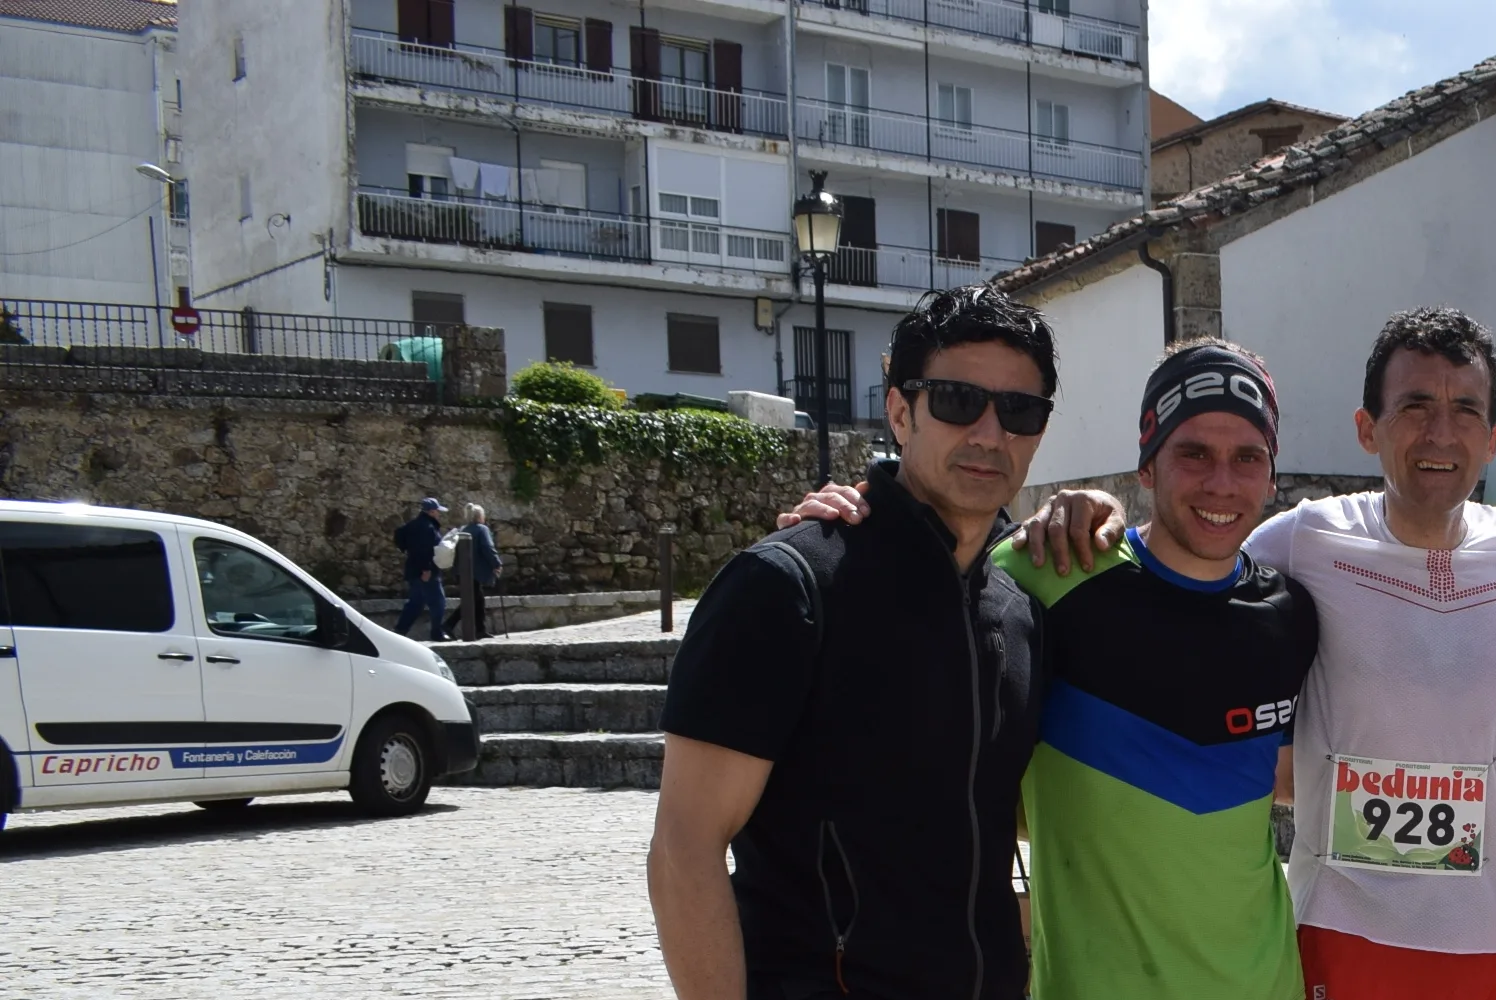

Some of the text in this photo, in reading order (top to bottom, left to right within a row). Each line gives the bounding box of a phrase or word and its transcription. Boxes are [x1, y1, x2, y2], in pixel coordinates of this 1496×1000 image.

[42, 754, 161, 776] Capricho
[237, 752, 243, 764] y
[245, 749, 297, 761] Calefacción
[1336, 761, 1484, 802] bedunia
[1363, 798, 1455, 846] 928
